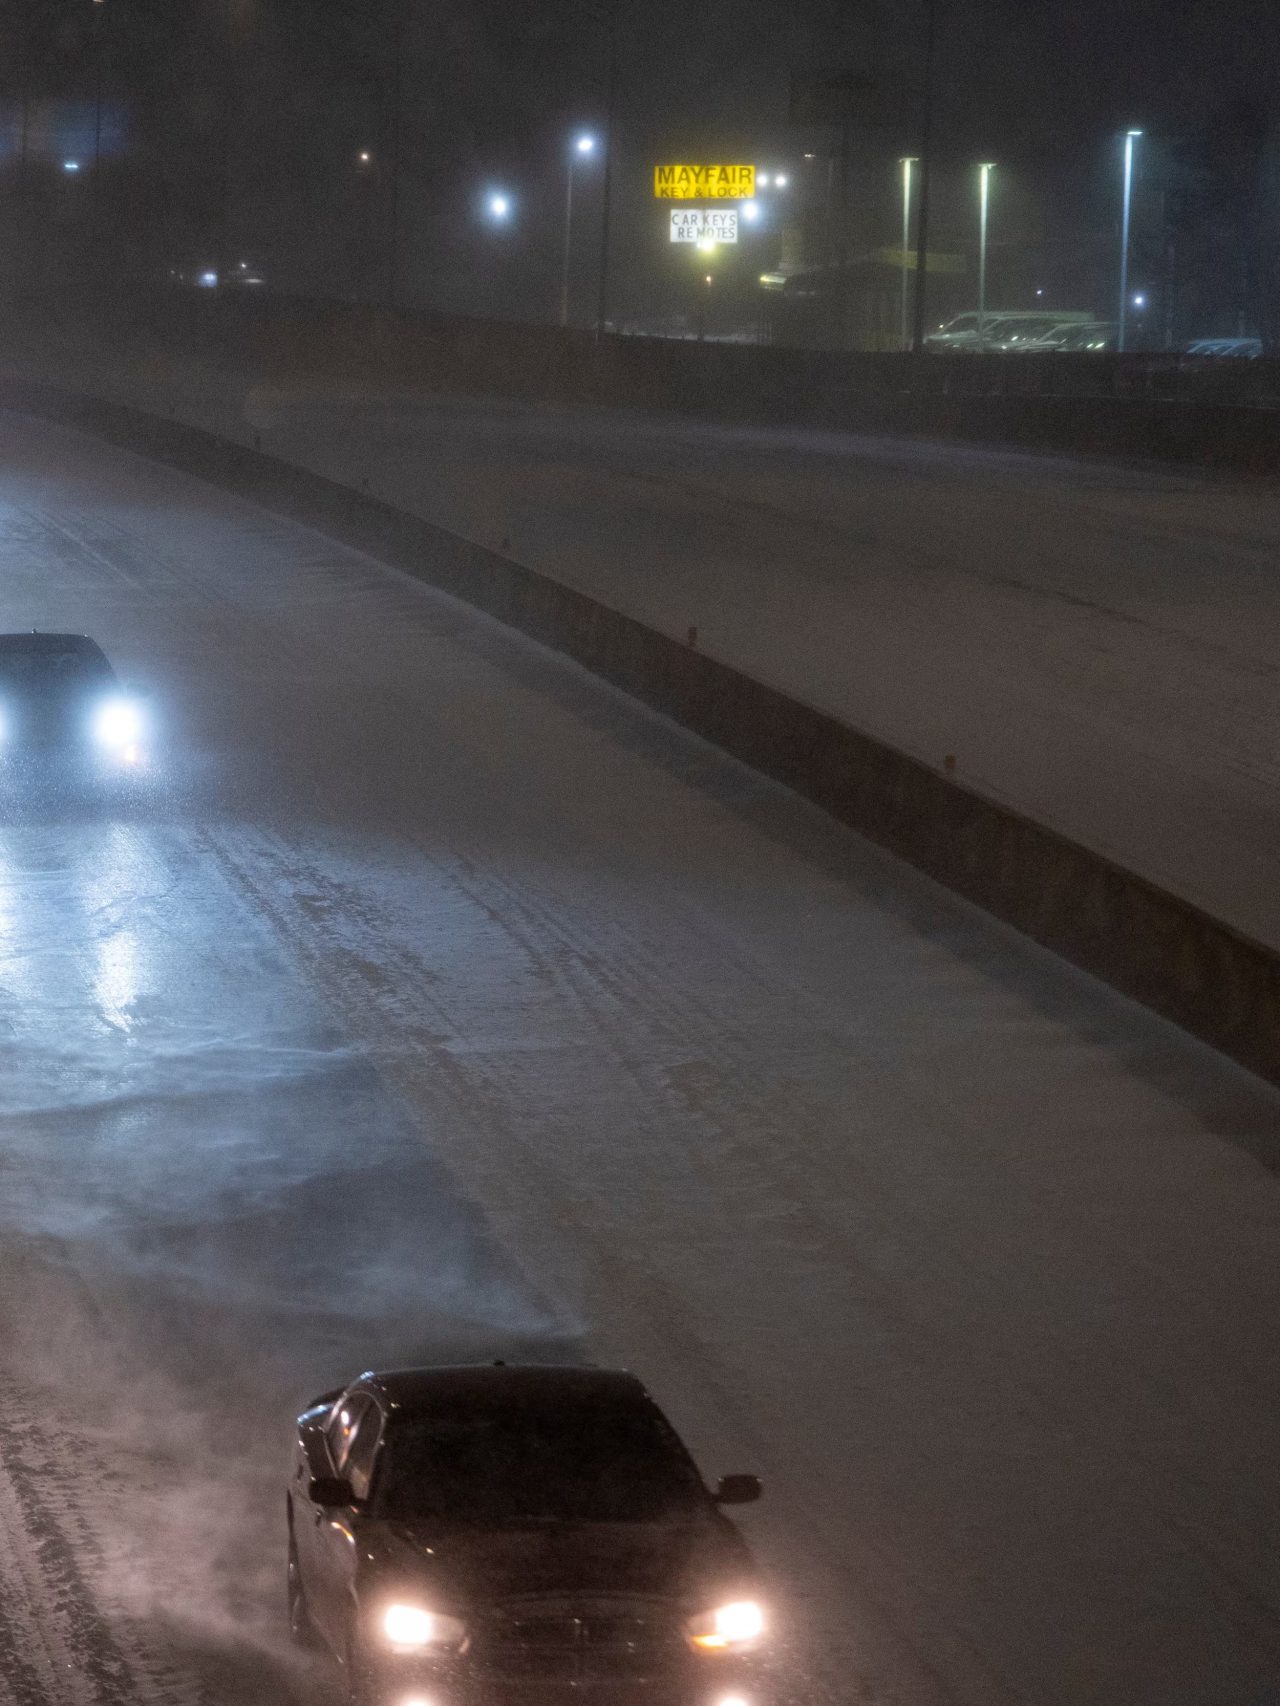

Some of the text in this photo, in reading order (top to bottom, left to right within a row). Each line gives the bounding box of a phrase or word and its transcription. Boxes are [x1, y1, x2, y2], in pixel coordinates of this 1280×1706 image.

[658, 167, 752, 184] MAYFAIR
[660, 187, 747, 197] KEY & LOCK
[672, 214, 736, 226] CAR KEYS
[678, 227, 735, 238] REMOTES
